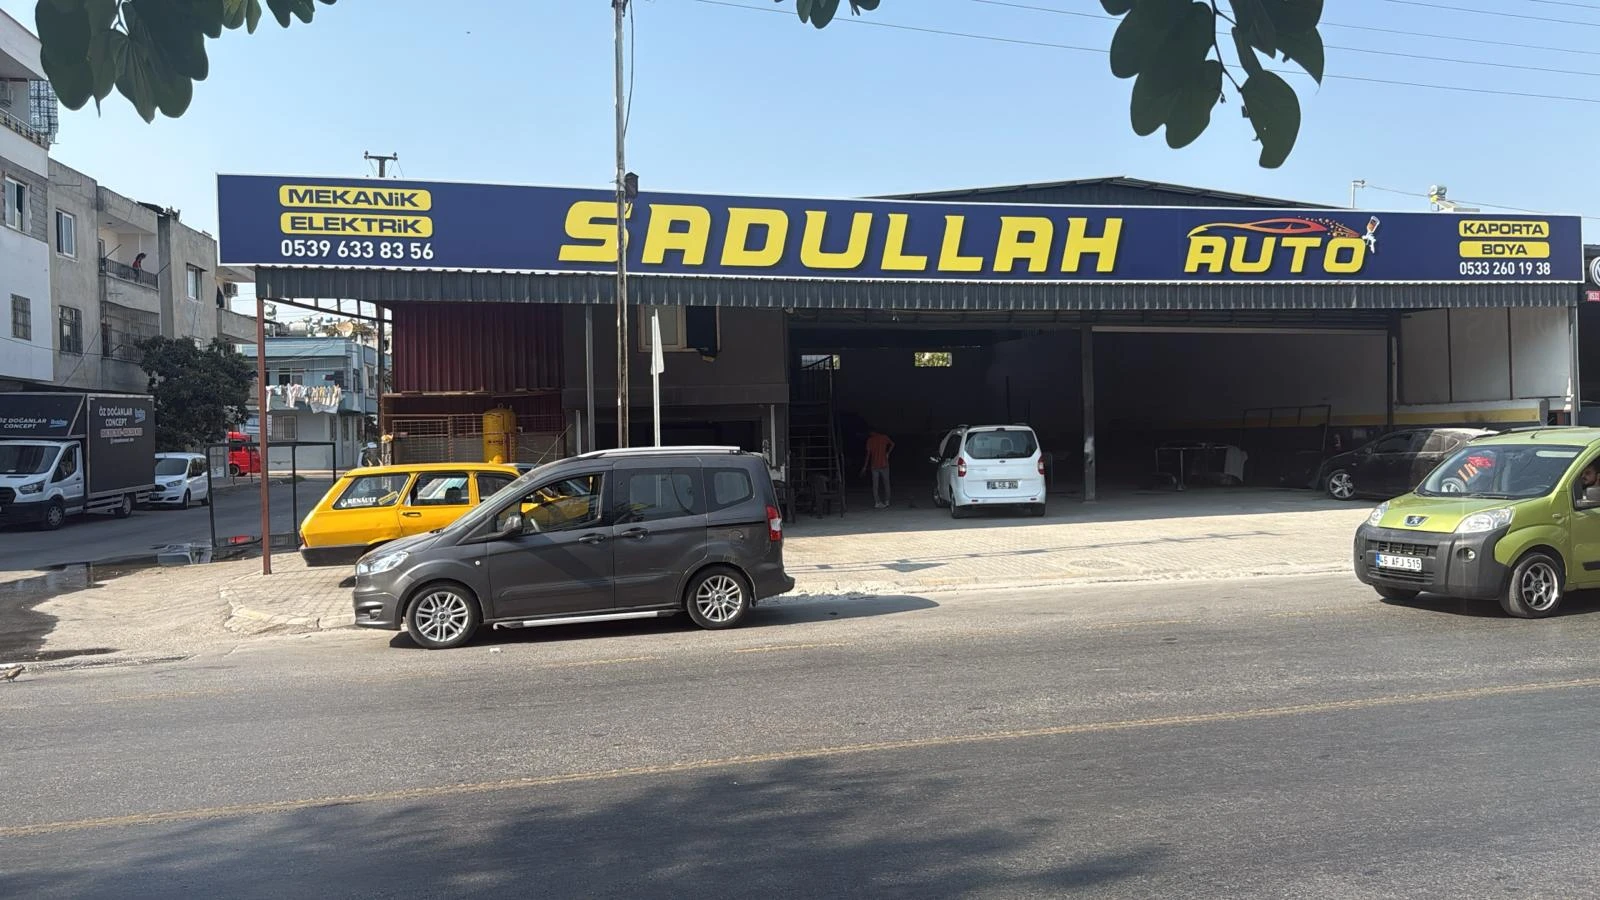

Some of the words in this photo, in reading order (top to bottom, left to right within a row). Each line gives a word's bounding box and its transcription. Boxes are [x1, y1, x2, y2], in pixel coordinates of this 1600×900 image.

[1463, 223, 1544, 235] KAPORTA
[558, 201, 1123, 273] SADULLAH
[1184, 236, 1366, 273] AUTO
[281, 239, 331, 257] 0539
[337, 240, 374, 258] 633
[380, 242, 404, 259] 83
[410, 243, 434, 260] 56
[1481, 243, 1528, 255] BOYA
[1459, 261, 1490, 275] 0533
[1493, 261, 1515, 275] 260
[1519, 262, 1533, 275] 19
[1536, 262, 1551, 275] 38
[105, 418, 128, 427] CONCEPT
[347, 496, 377, 504] RENAULT
[1391, 557, 1405, 567] AFJ
[1407, 558, 1421, 569] 515
